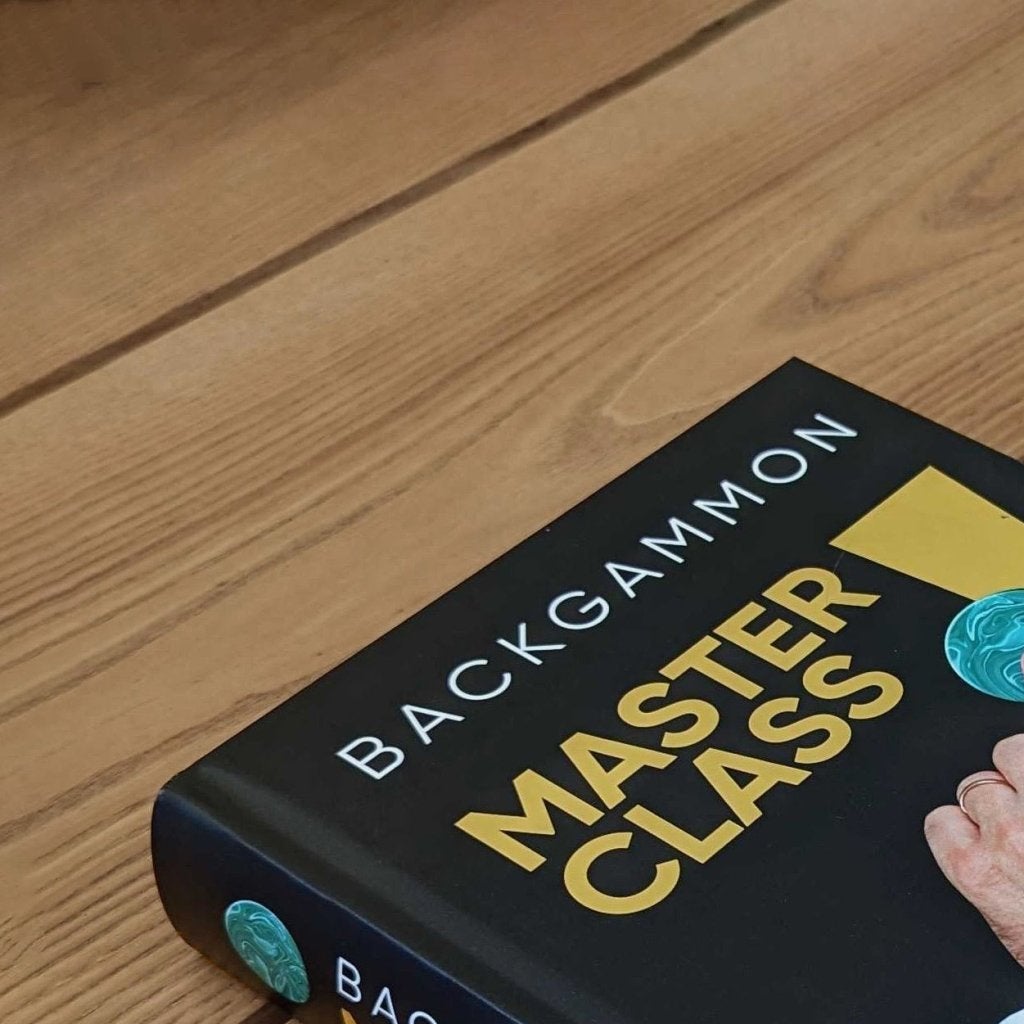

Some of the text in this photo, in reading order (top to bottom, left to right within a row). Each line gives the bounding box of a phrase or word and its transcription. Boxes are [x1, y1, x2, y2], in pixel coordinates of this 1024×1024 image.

[335, 412, 859, 780] BACKGAMMON
[453, 566, 882, 873] MASTER
[563, 654, 904, 915] CLASS
